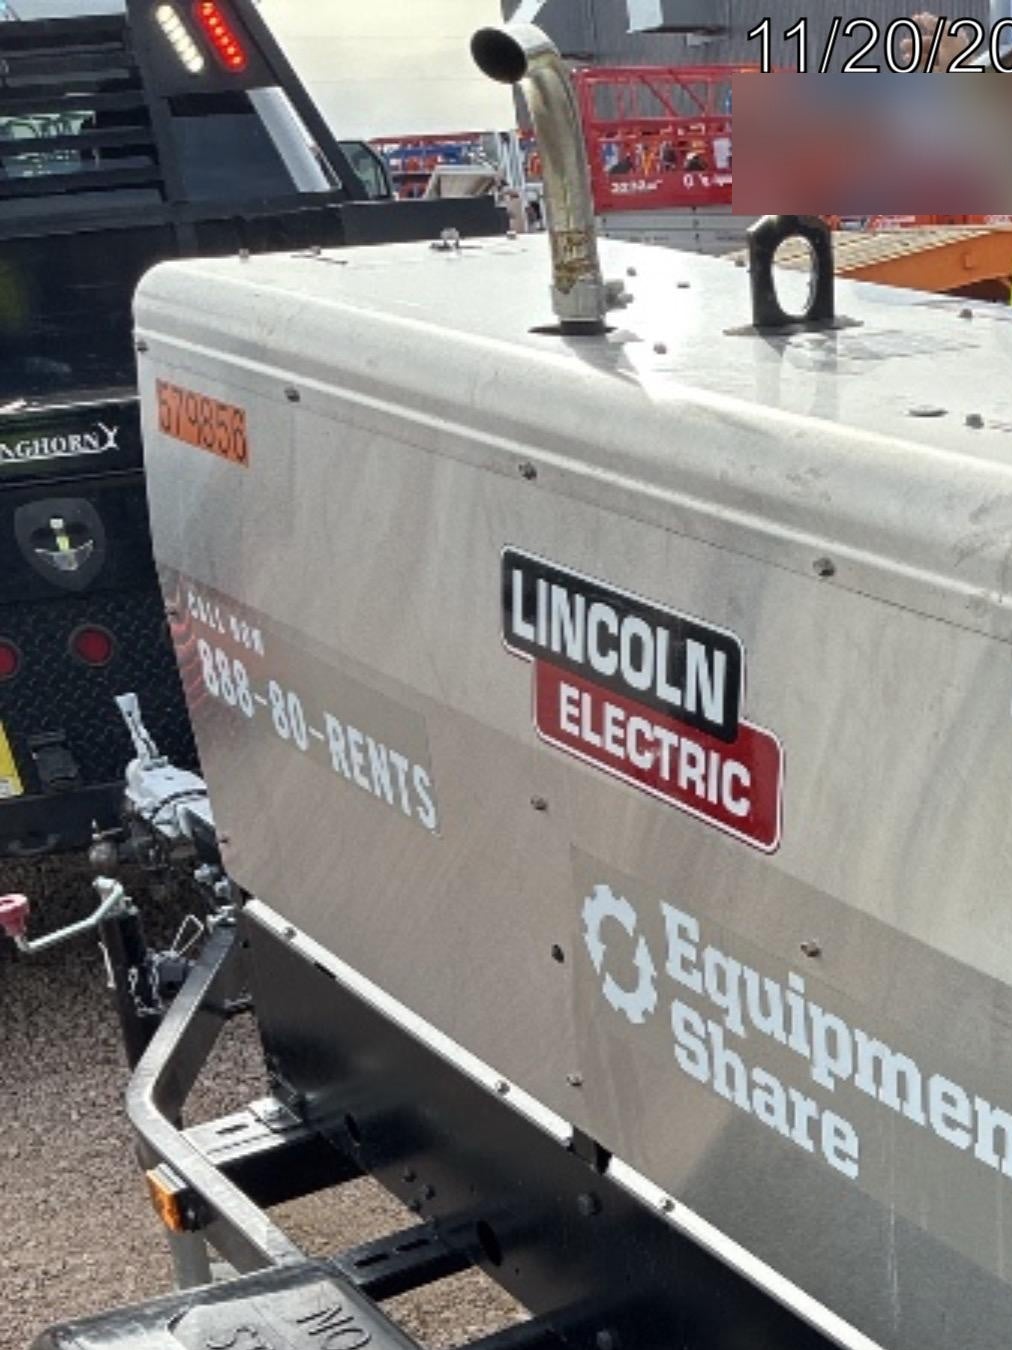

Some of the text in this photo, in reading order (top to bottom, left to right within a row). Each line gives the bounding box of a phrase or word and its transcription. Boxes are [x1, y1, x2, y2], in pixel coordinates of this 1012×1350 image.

[512, 569, 727, 725] LINCOLN
[197, 638, 437, 829] 888-80-RENTS
[559, 681, 751, 817] ELECTRIC
